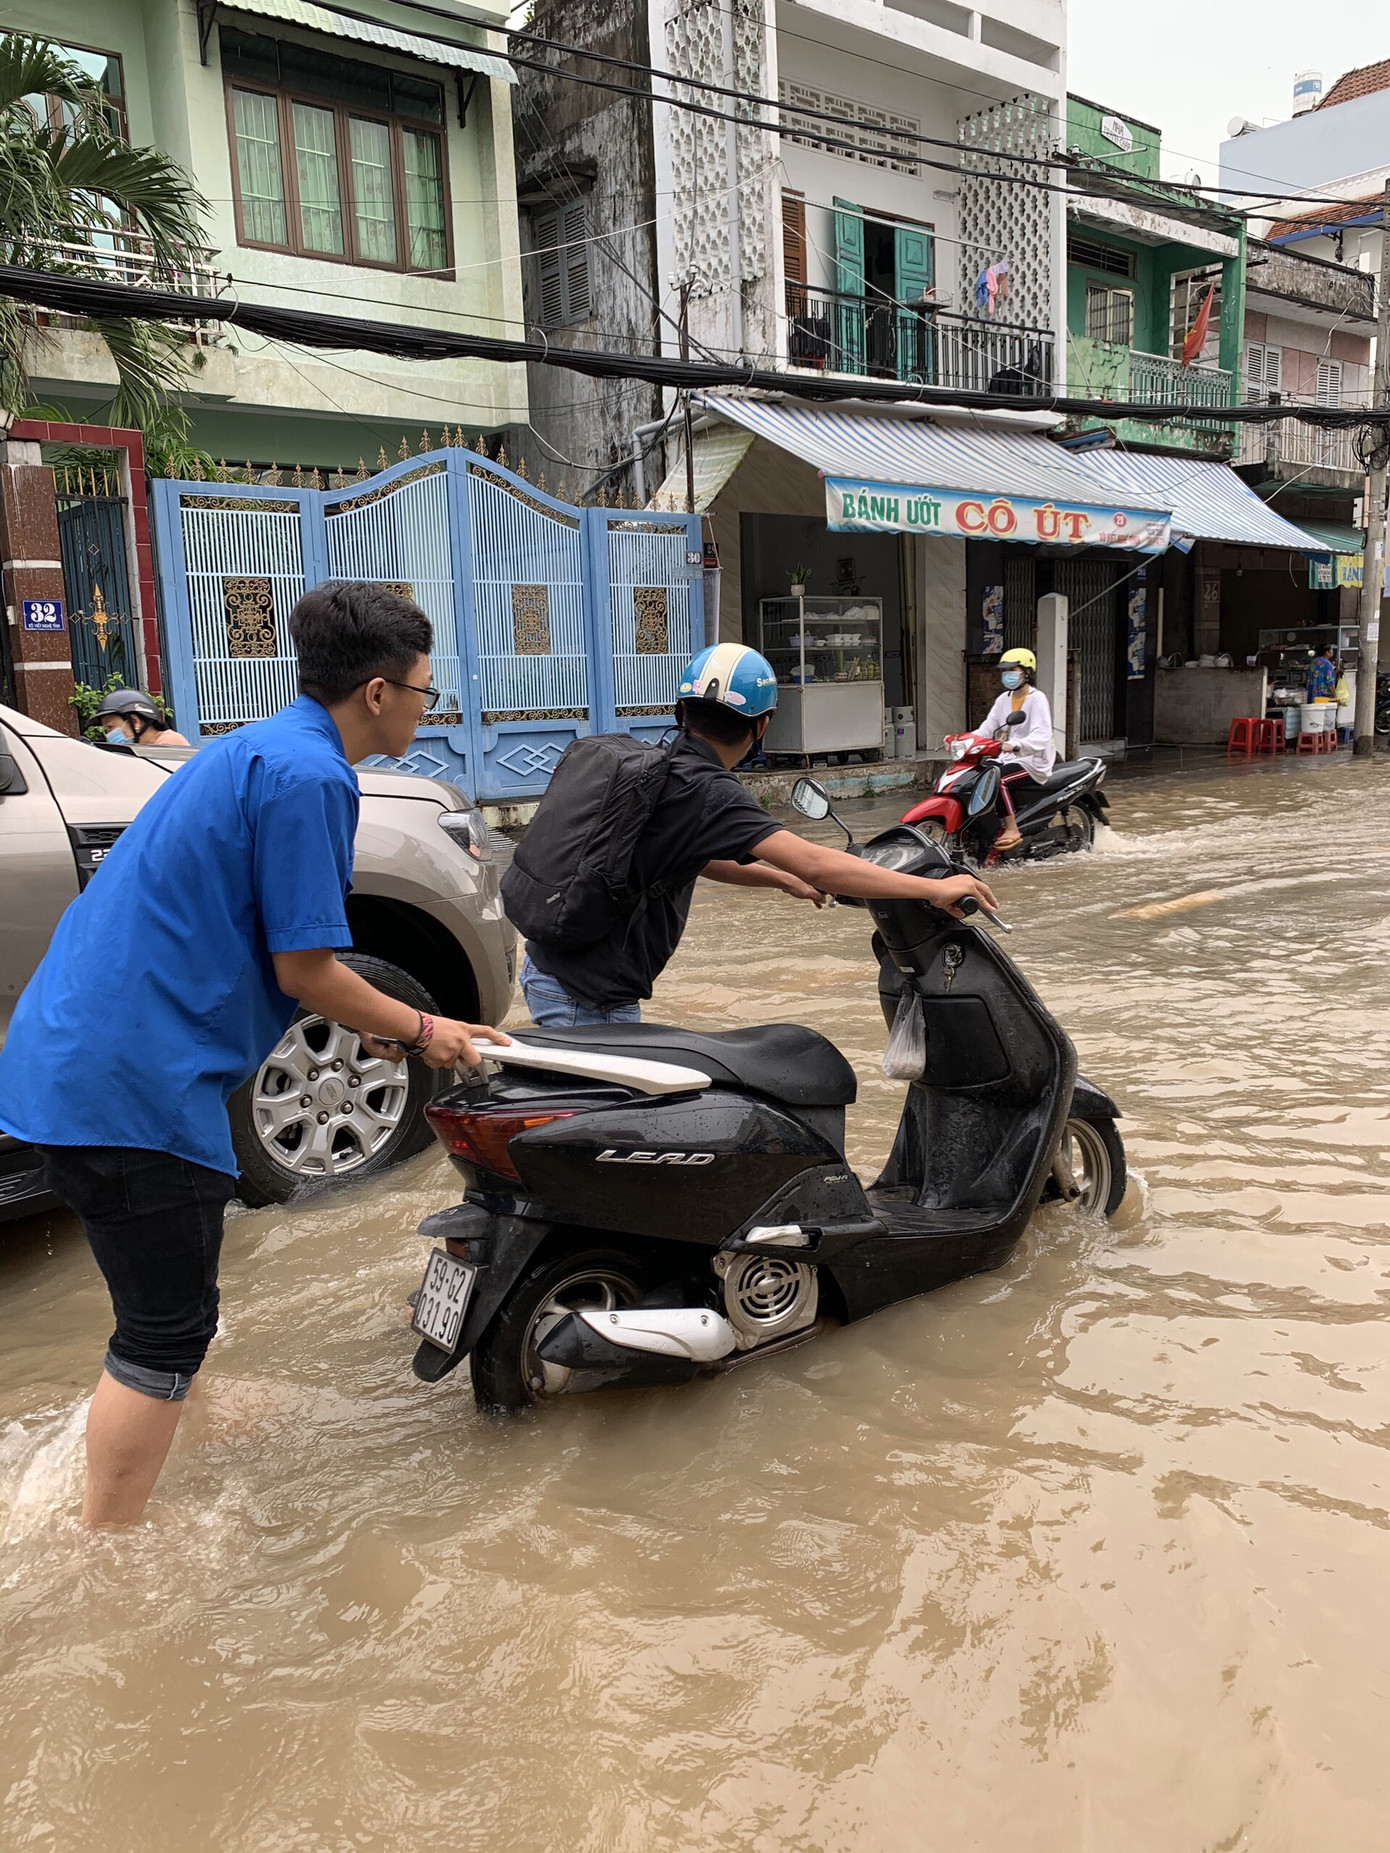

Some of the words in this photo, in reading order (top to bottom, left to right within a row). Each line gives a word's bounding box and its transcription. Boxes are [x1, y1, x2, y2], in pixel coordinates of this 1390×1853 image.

[841, 488, 900, 524] BÁNH
[906, 495, 942, 526] ƯỚT
[955, 498, 1017, 537] CÔ
[1033, 503, 1091, 543] ÚT
[687, 552, 701, 564] 30
[1203, 583, 1218, 600] 26
[31, 603, 57, 623] 32
[595, 1149, 716, 1166] LEAD
[415, 1292, 460, 1345] 031.90
